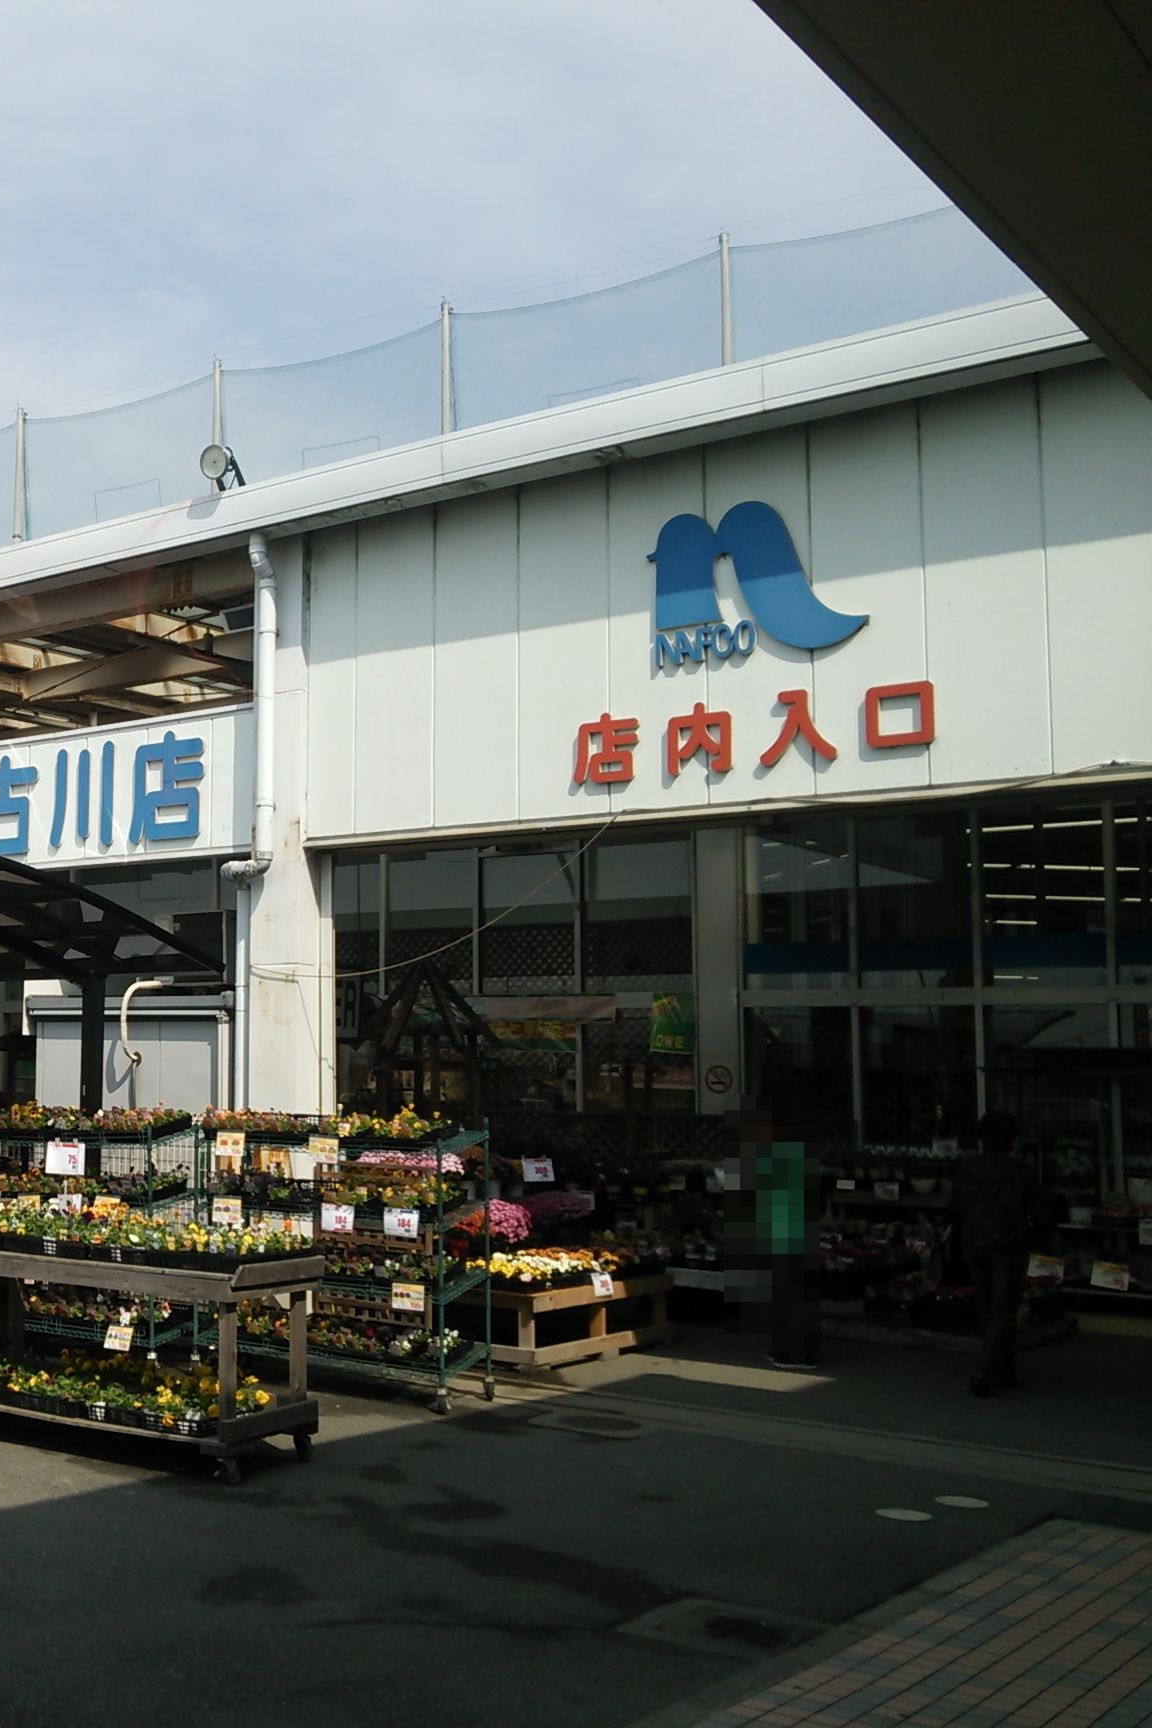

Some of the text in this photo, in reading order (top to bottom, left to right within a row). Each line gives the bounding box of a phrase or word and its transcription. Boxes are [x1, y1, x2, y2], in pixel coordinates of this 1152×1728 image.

[655, 619, 757, 669] NAFCO
[573, 680, 936, 785] 店内入口
[68, 1154, 77, 1165] 75
